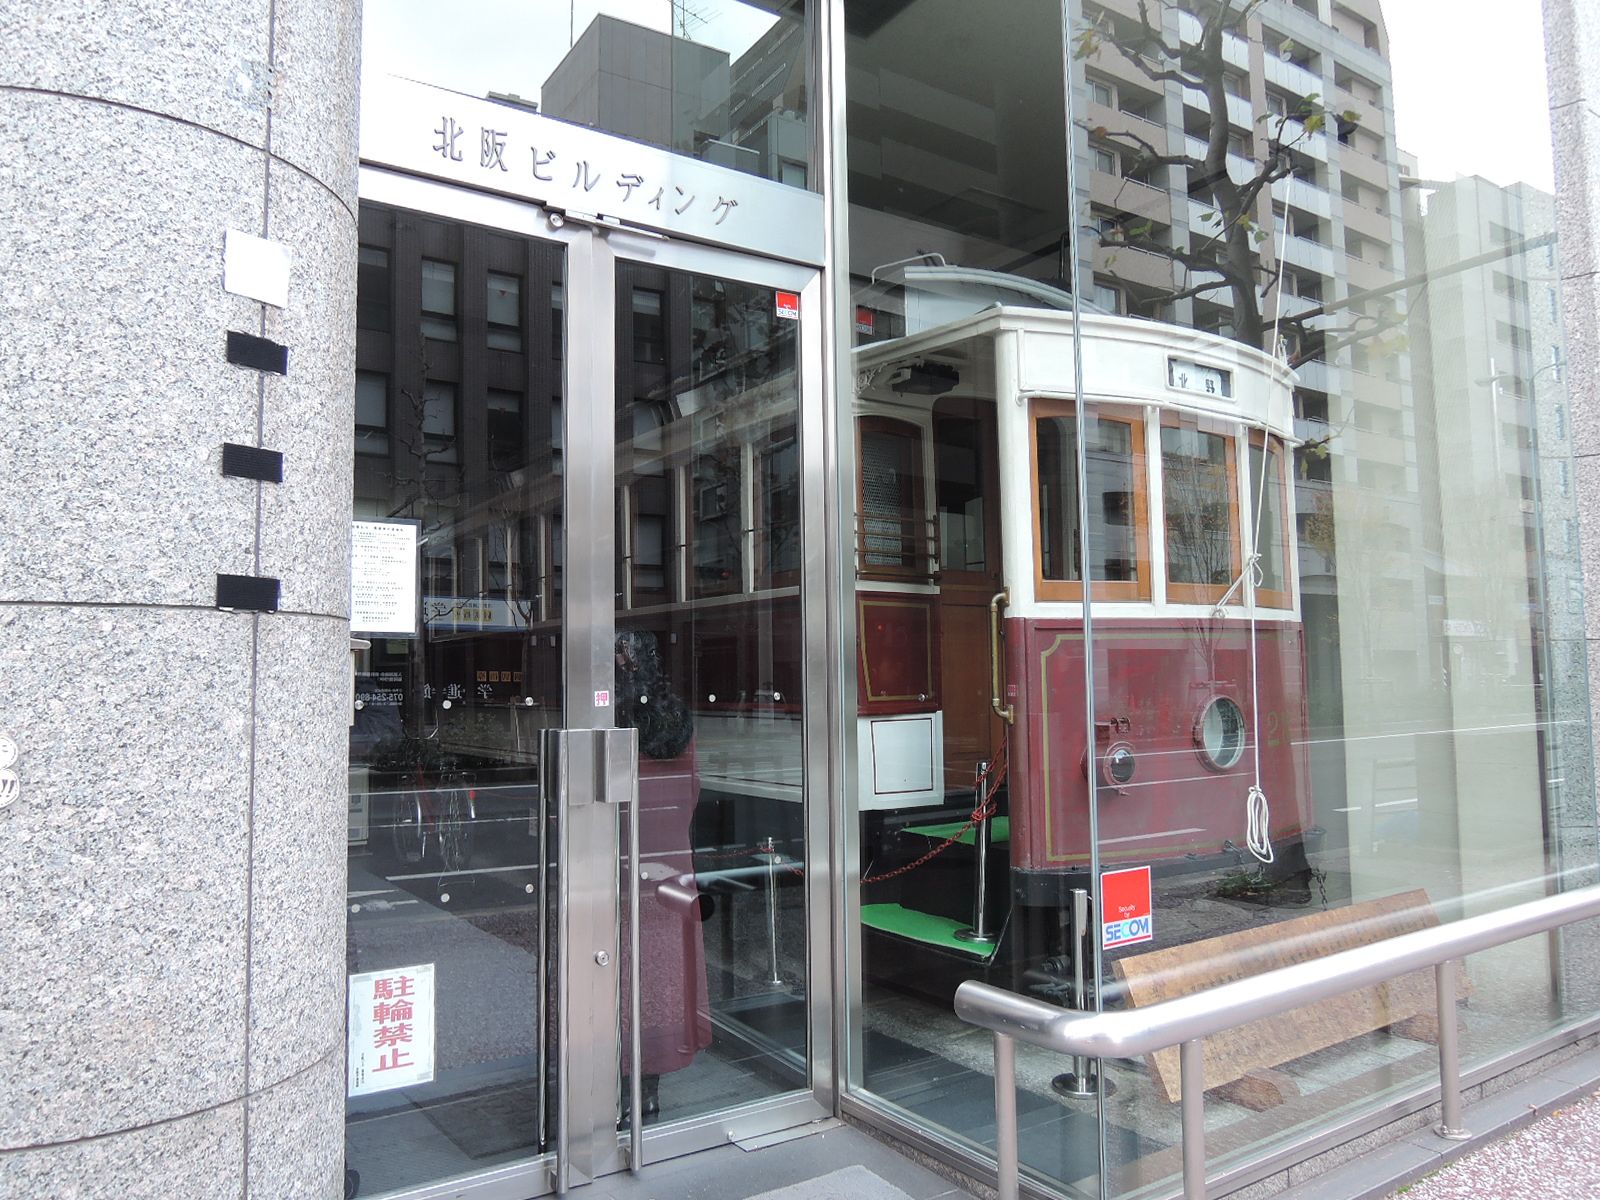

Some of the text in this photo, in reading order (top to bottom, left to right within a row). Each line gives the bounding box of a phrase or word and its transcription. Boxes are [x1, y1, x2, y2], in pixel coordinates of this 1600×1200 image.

[432, 116, 739, 225] 北阪ビルディング
[1105, 917, 1149, 942] SECOM
[372, 975, 415, 1073] 駐輪禁止
